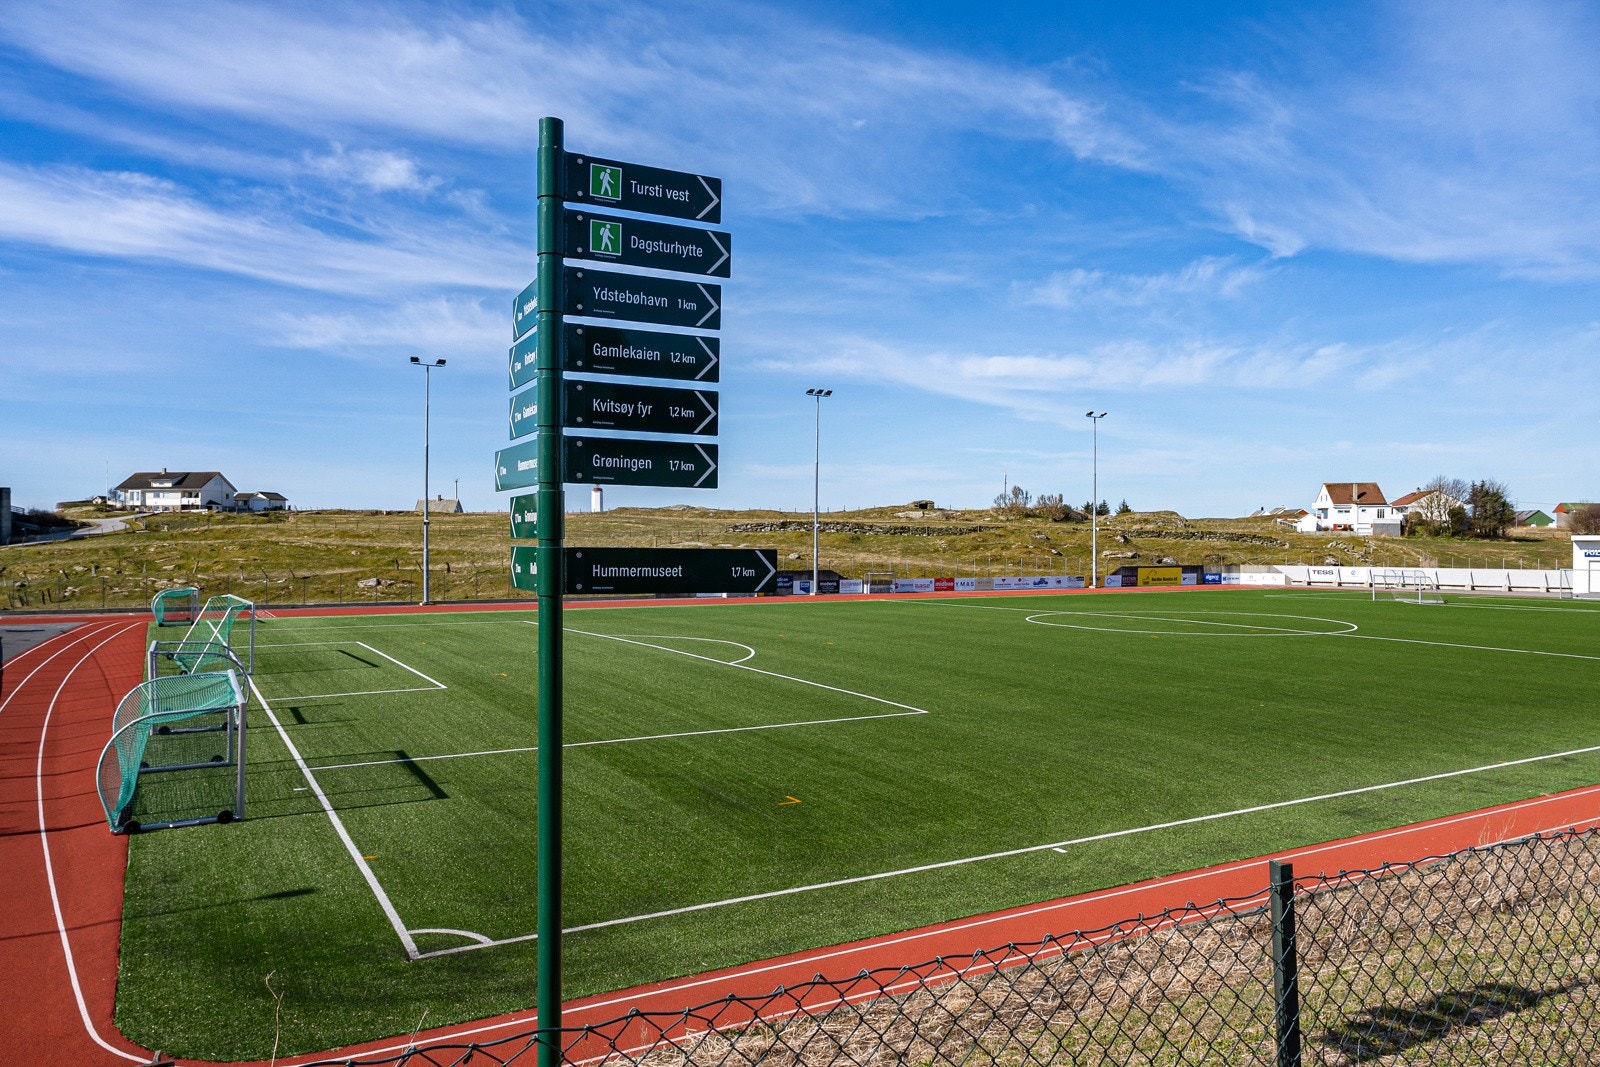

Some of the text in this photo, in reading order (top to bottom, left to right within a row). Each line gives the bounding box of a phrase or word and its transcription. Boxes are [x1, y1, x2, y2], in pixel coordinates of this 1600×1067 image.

[630, 180, 690, 202] Tursti vest
[630, 235, 703, 258] Dagsturhytte
[593, 286, 668, 307] Ydstebøhavn
[593, 342, 661, 361] Gamlekaien
[682, 353, 696, 364] km
[593, 398, 635, 417] Kvitsøy
[637, 401, 653, 418] fyr
[681, 408, 695, 418] km
[592, 454, 652, 472] Grøningen
[681, 461, 695, 471] km
[592, 564, 683, 577] Hummermuseet
[742, 567, 756, 577] km
